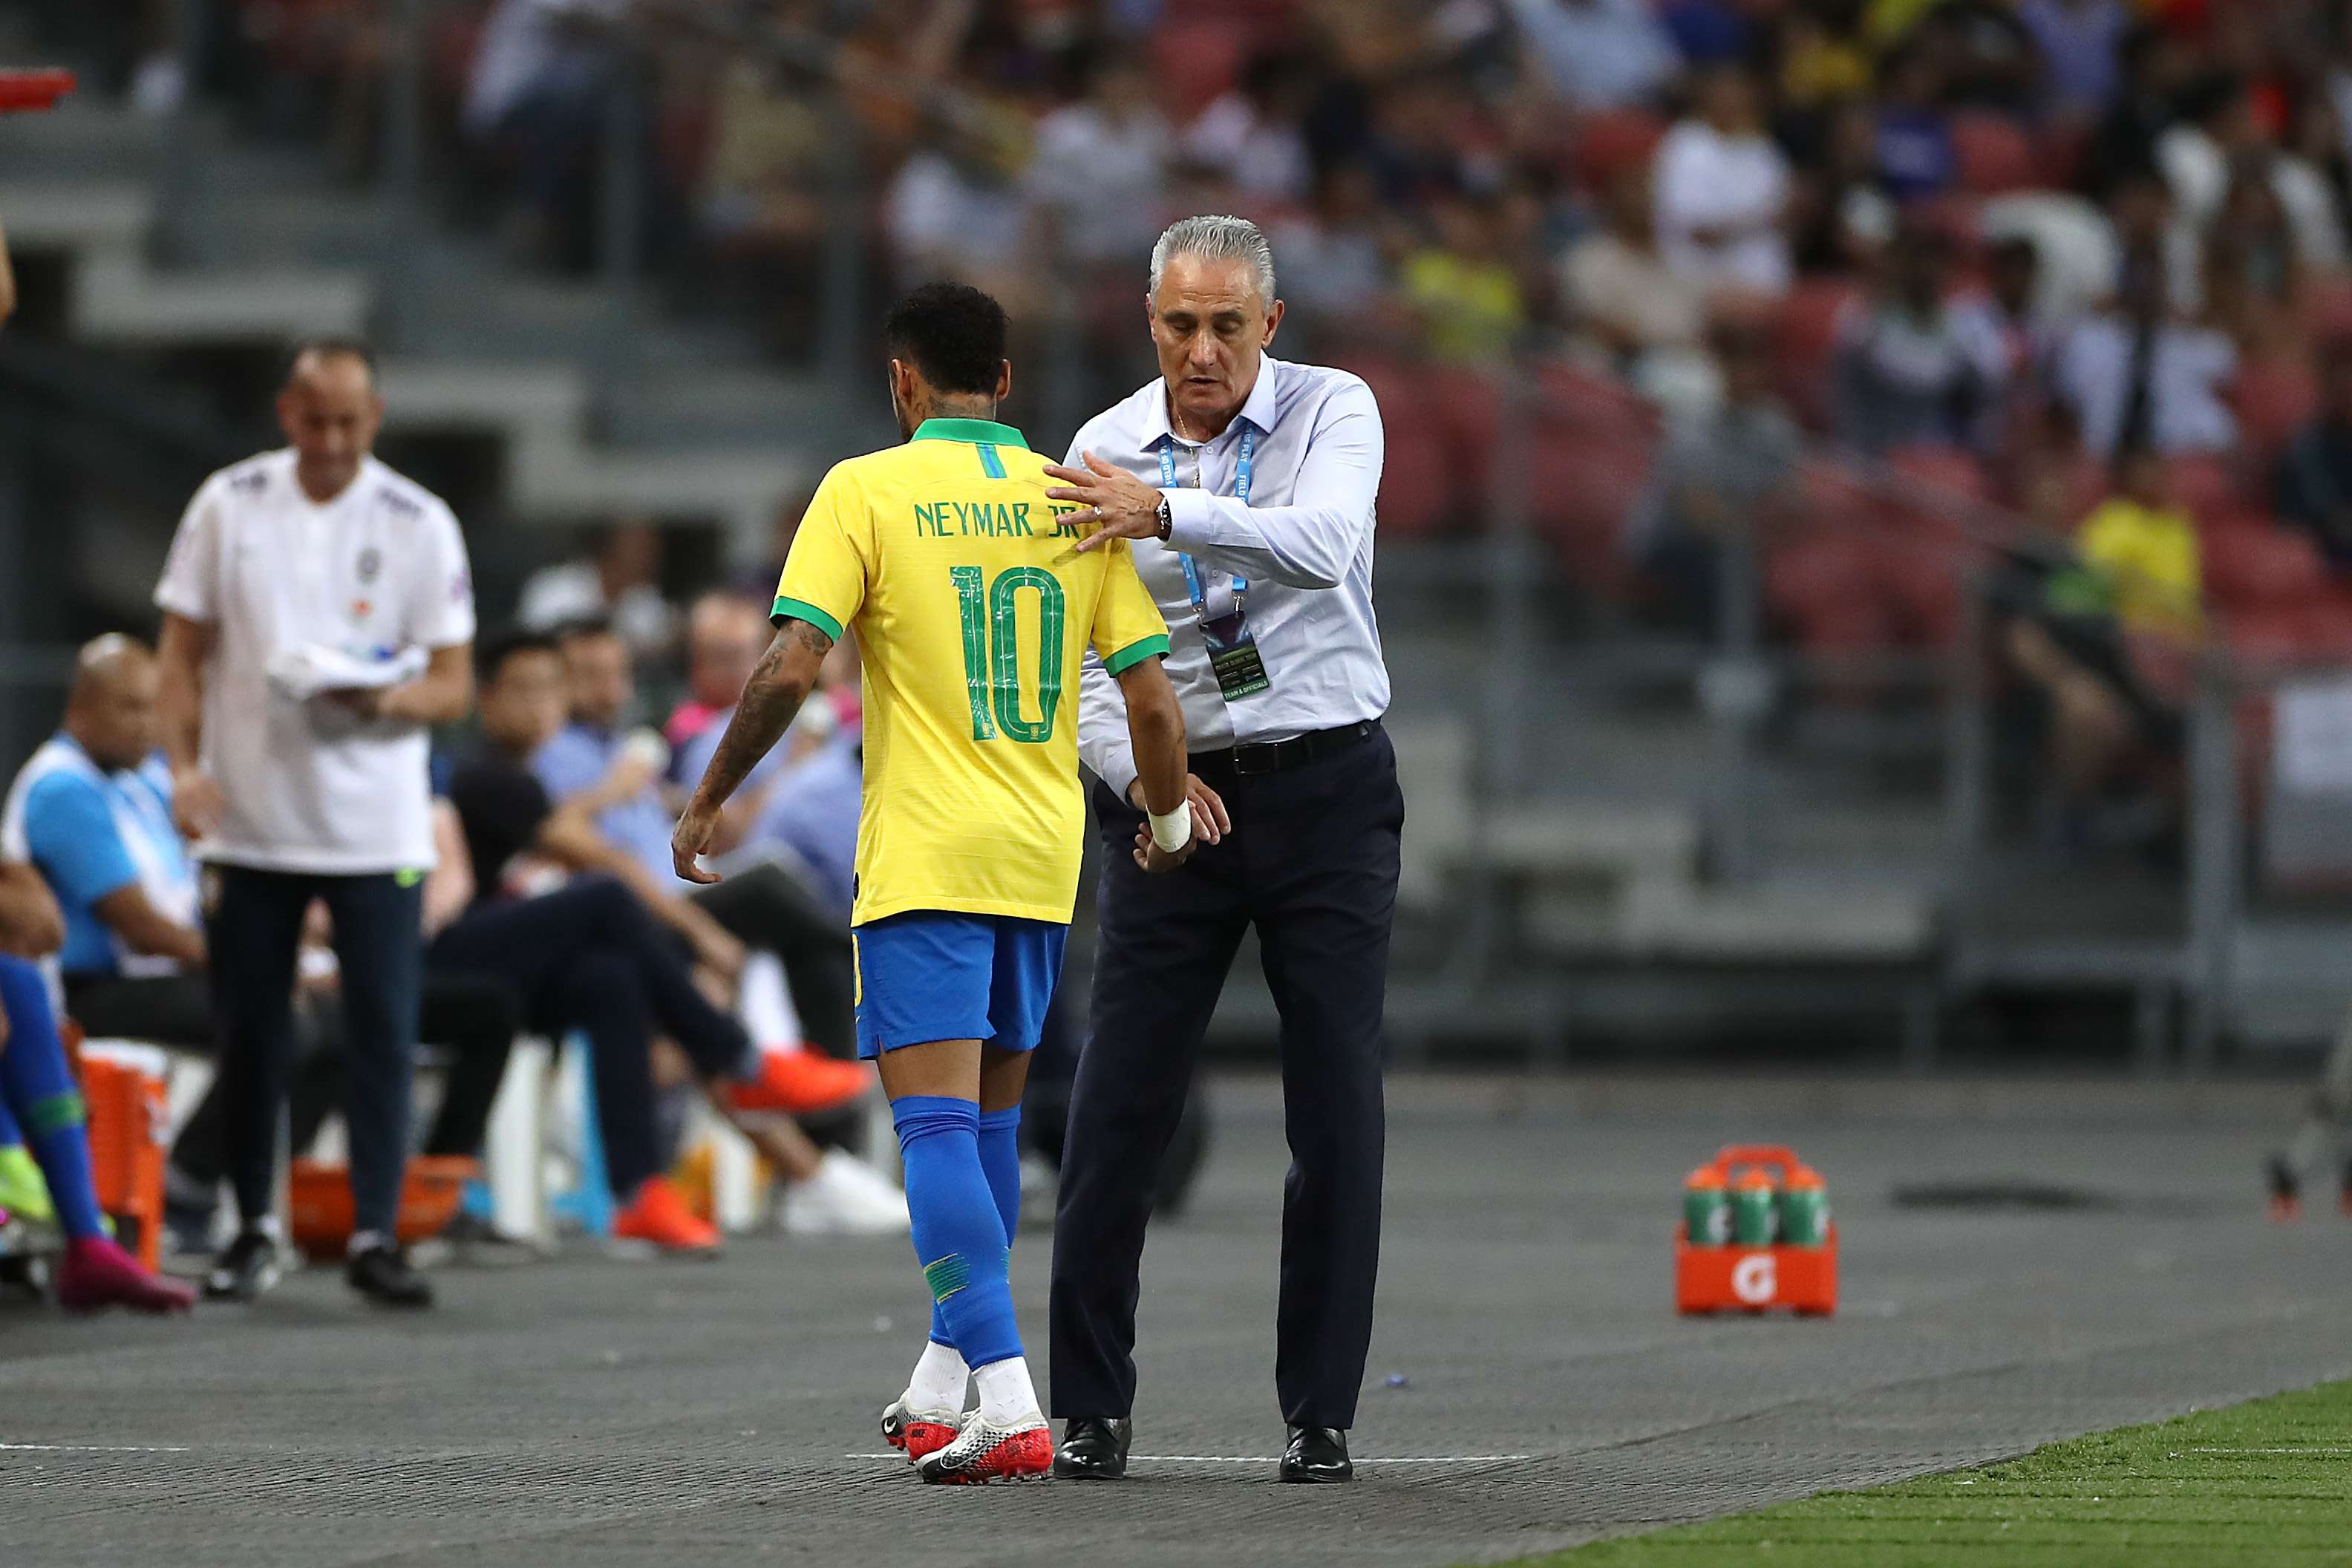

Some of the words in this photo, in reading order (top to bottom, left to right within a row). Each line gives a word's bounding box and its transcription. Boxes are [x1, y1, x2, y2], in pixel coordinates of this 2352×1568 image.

[1241, 444, 1249, 463] PLAY
[1163, 464, 1173, 485] FIELD
[1238, 474, 1247, 496] FIELD
[914, 502, 1033, 537] NEYMAR
[1048, 505, 1079, 539] JR
[950, 566, 1065, 743] 10
[1224, 690, 1239, 699] TEAM
[1243, 680, 1268, 693] OFFICIALS
